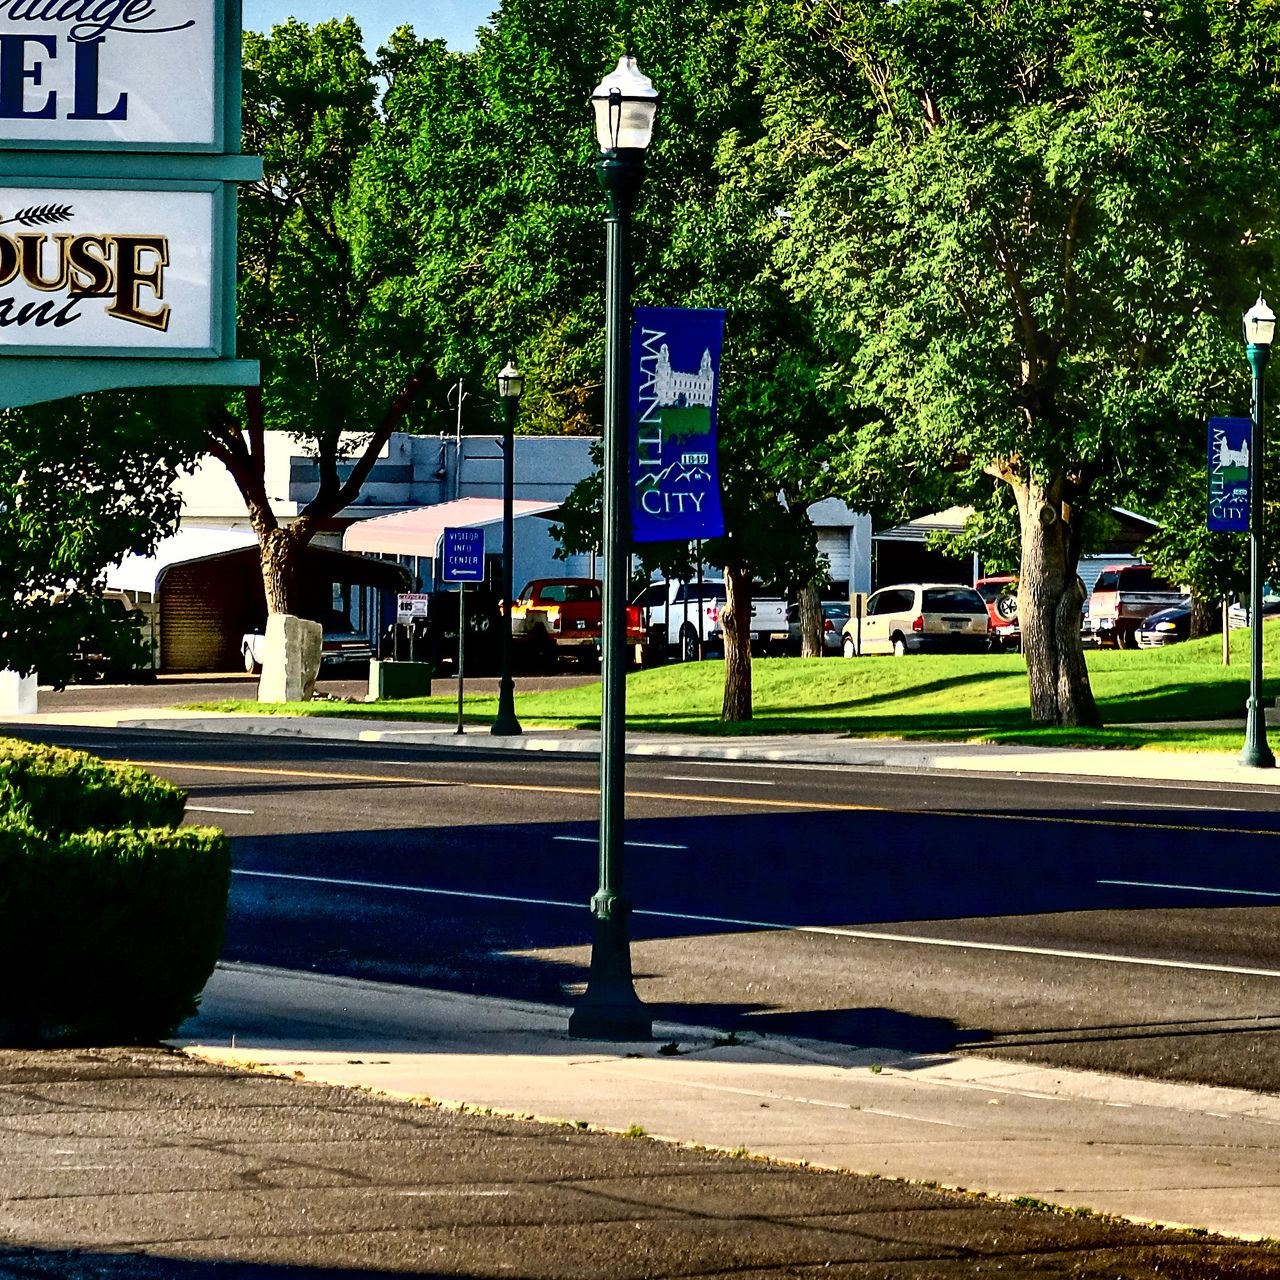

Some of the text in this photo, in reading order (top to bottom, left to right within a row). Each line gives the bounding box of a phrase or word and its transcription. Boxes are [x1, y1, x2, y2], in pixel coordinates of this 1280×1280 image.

[638, 326, 667, 466] MANTI
[682, 455, 708, 464] 1849
[641, 489, 706, 514] CITY
[1212, 505, 1244, 519] CITY
[449, 532, 479, 541] VISITOR
[453, 544, 472, 552] INFO
[449, 556, 478, 564] CENTER
